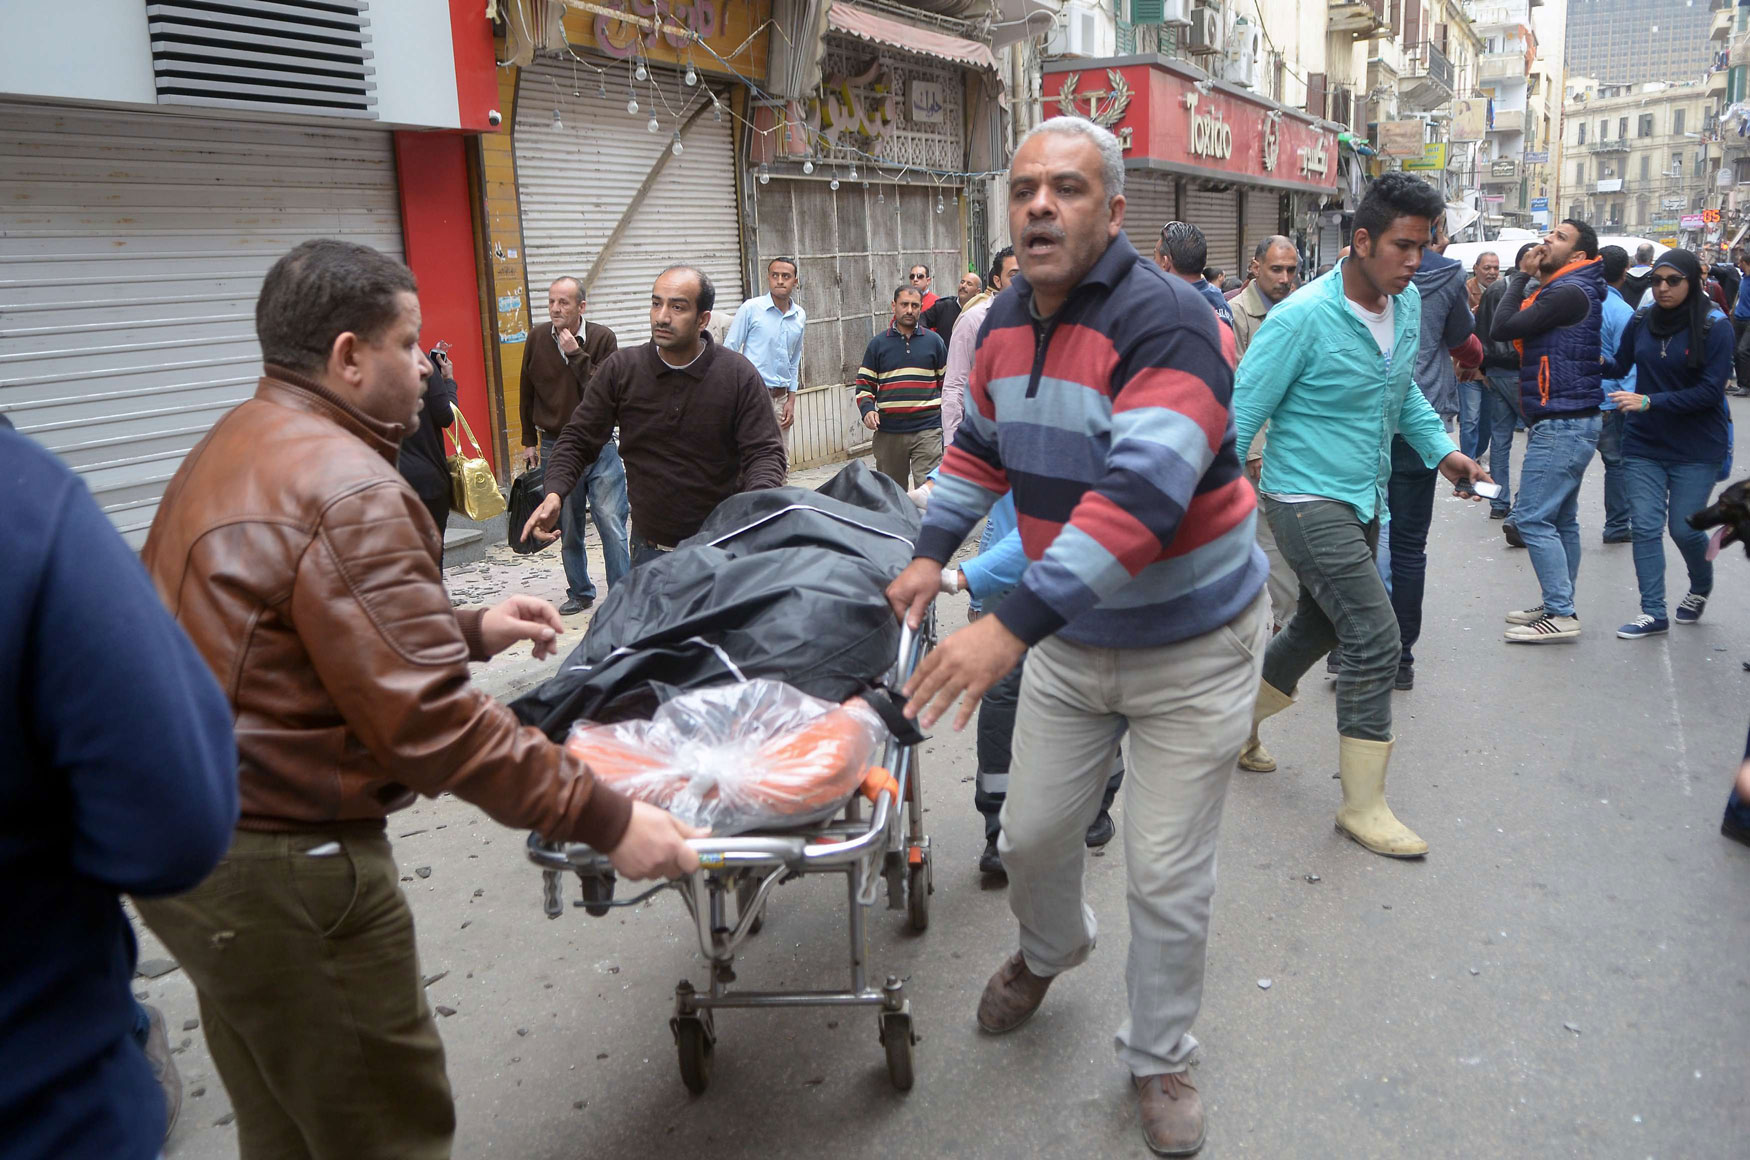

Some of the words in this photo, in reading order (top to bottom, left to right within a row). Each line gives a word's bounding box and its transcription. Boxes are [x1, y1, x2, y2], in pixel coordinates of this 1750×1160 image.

[913, 90, 943, 118] حلويات
[1186, 91, 1232, 160] Toxido
[1702, 209, 1721, 223] 05
